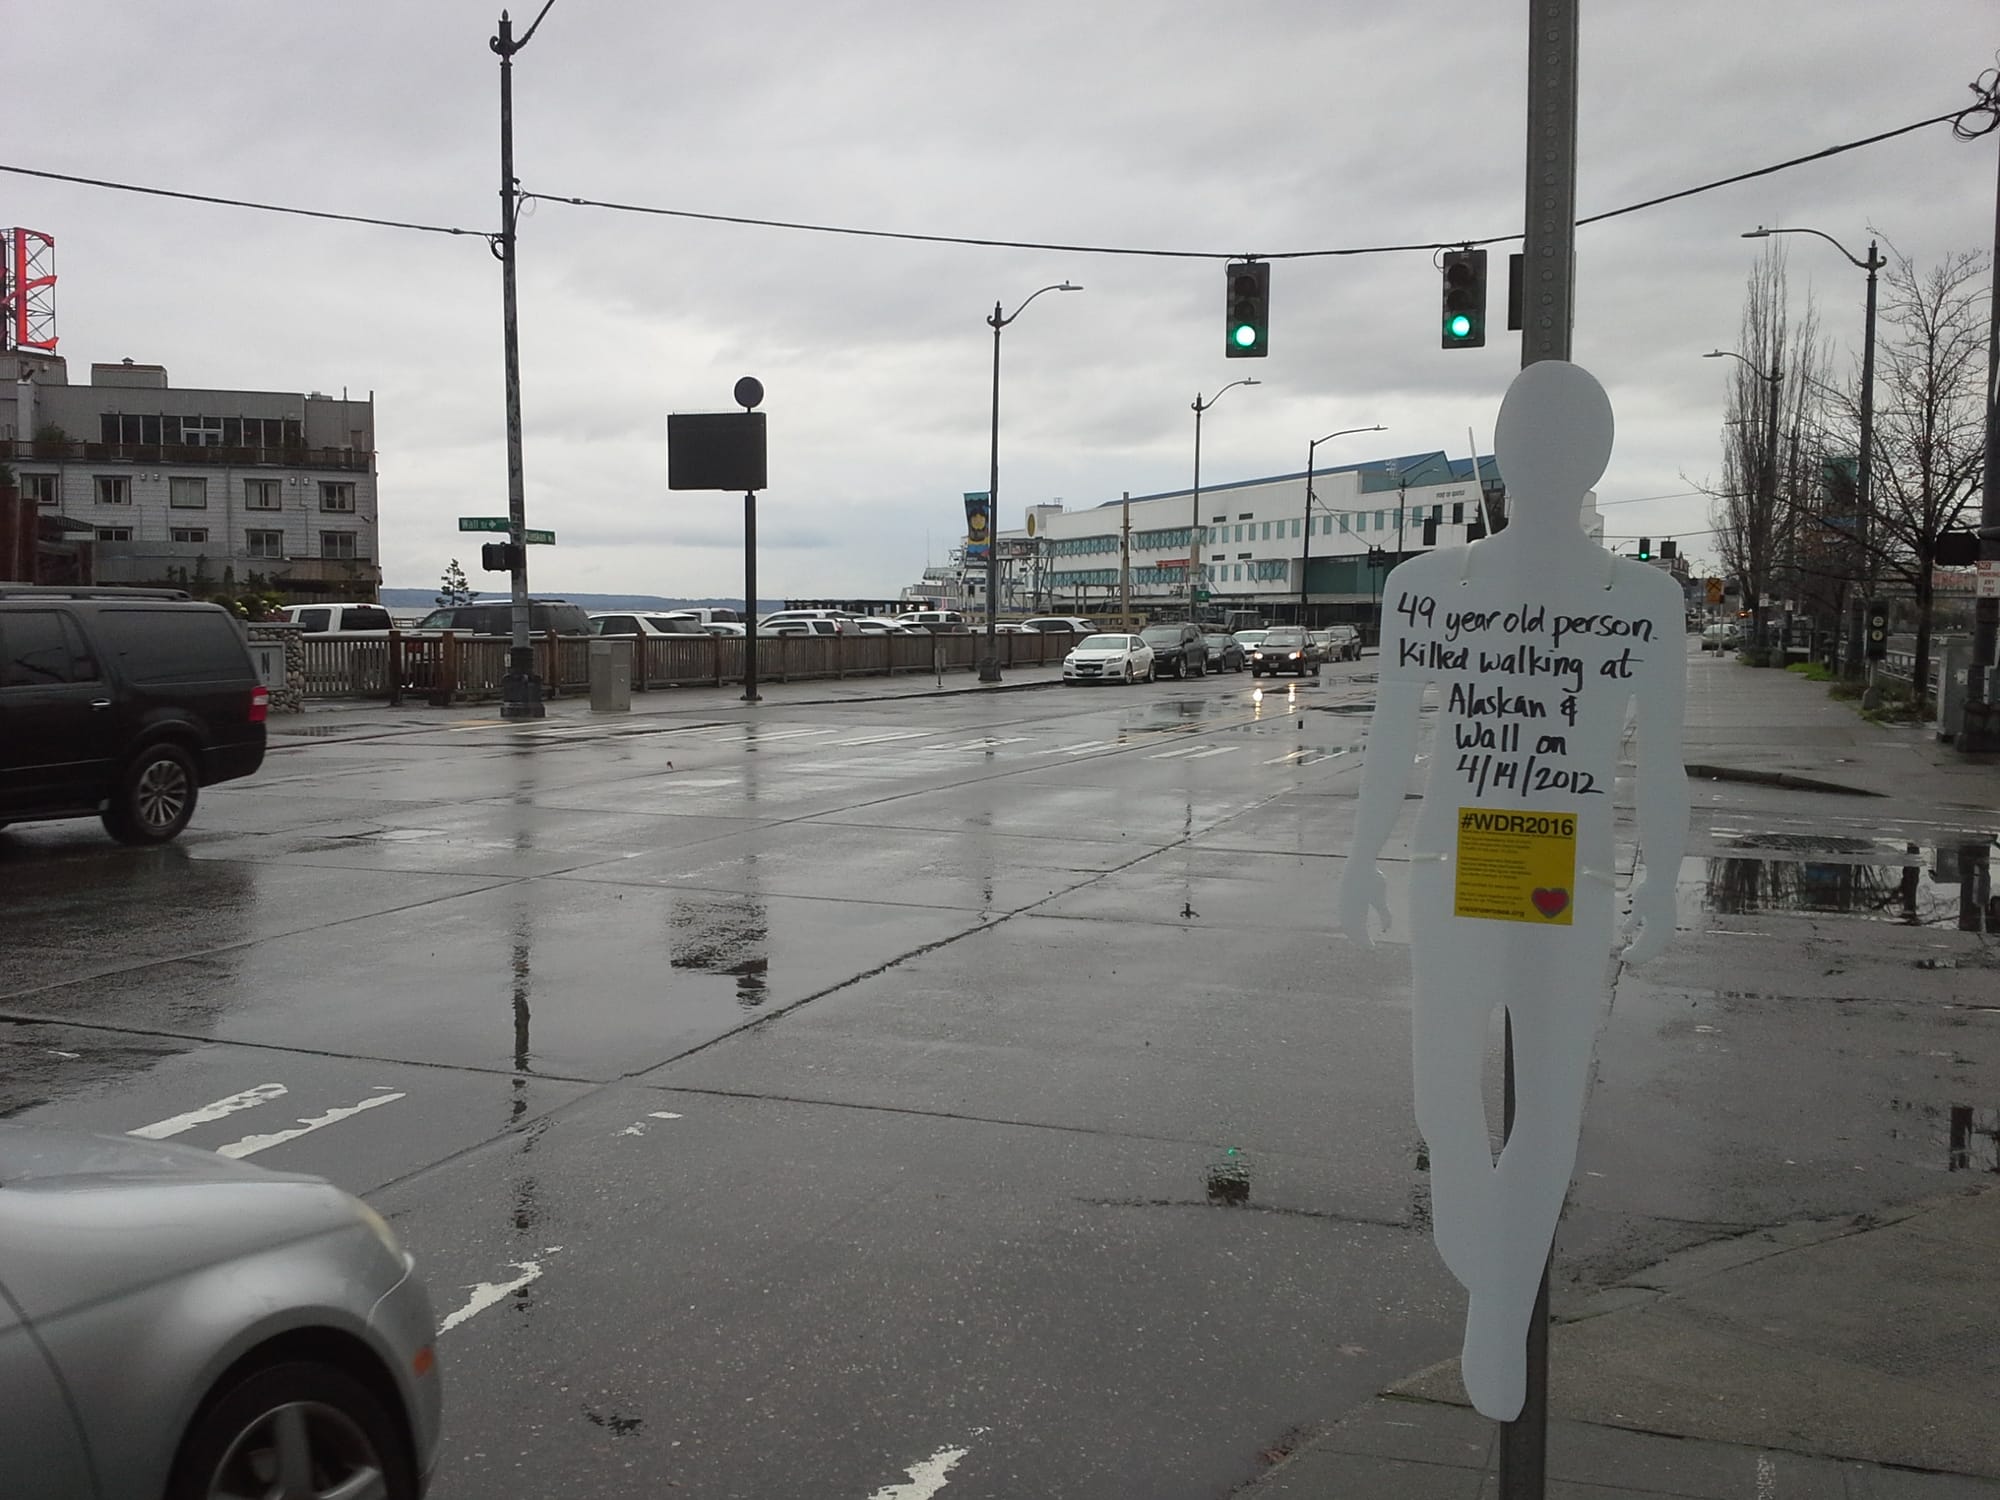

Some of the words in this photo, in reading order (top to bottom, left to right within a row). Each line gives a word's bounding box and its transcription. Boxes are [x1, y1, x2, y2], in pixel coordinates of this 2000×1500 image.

[461, 519, 478, 529] Wall
[1978, 562, 1991, 570] NO
[1397, 592, 1436, 629] 49
[1446, 609, 1501, 642] year
[1503, 603, 1545, 634] old
[1479, 645, 1584, 693] walking
[1600, 648, 1645, 679] at
[1448, 682, 1547, 719] Alaskan
[1560, 694, 1579, 727] &
[1455, 721, 1520, 753] Wall
[1536, 735, 1568, 756] on
[1456, 754, 1606, 798] 4/14/2012
[1460, 812, 1574, 837] #WDR2016
